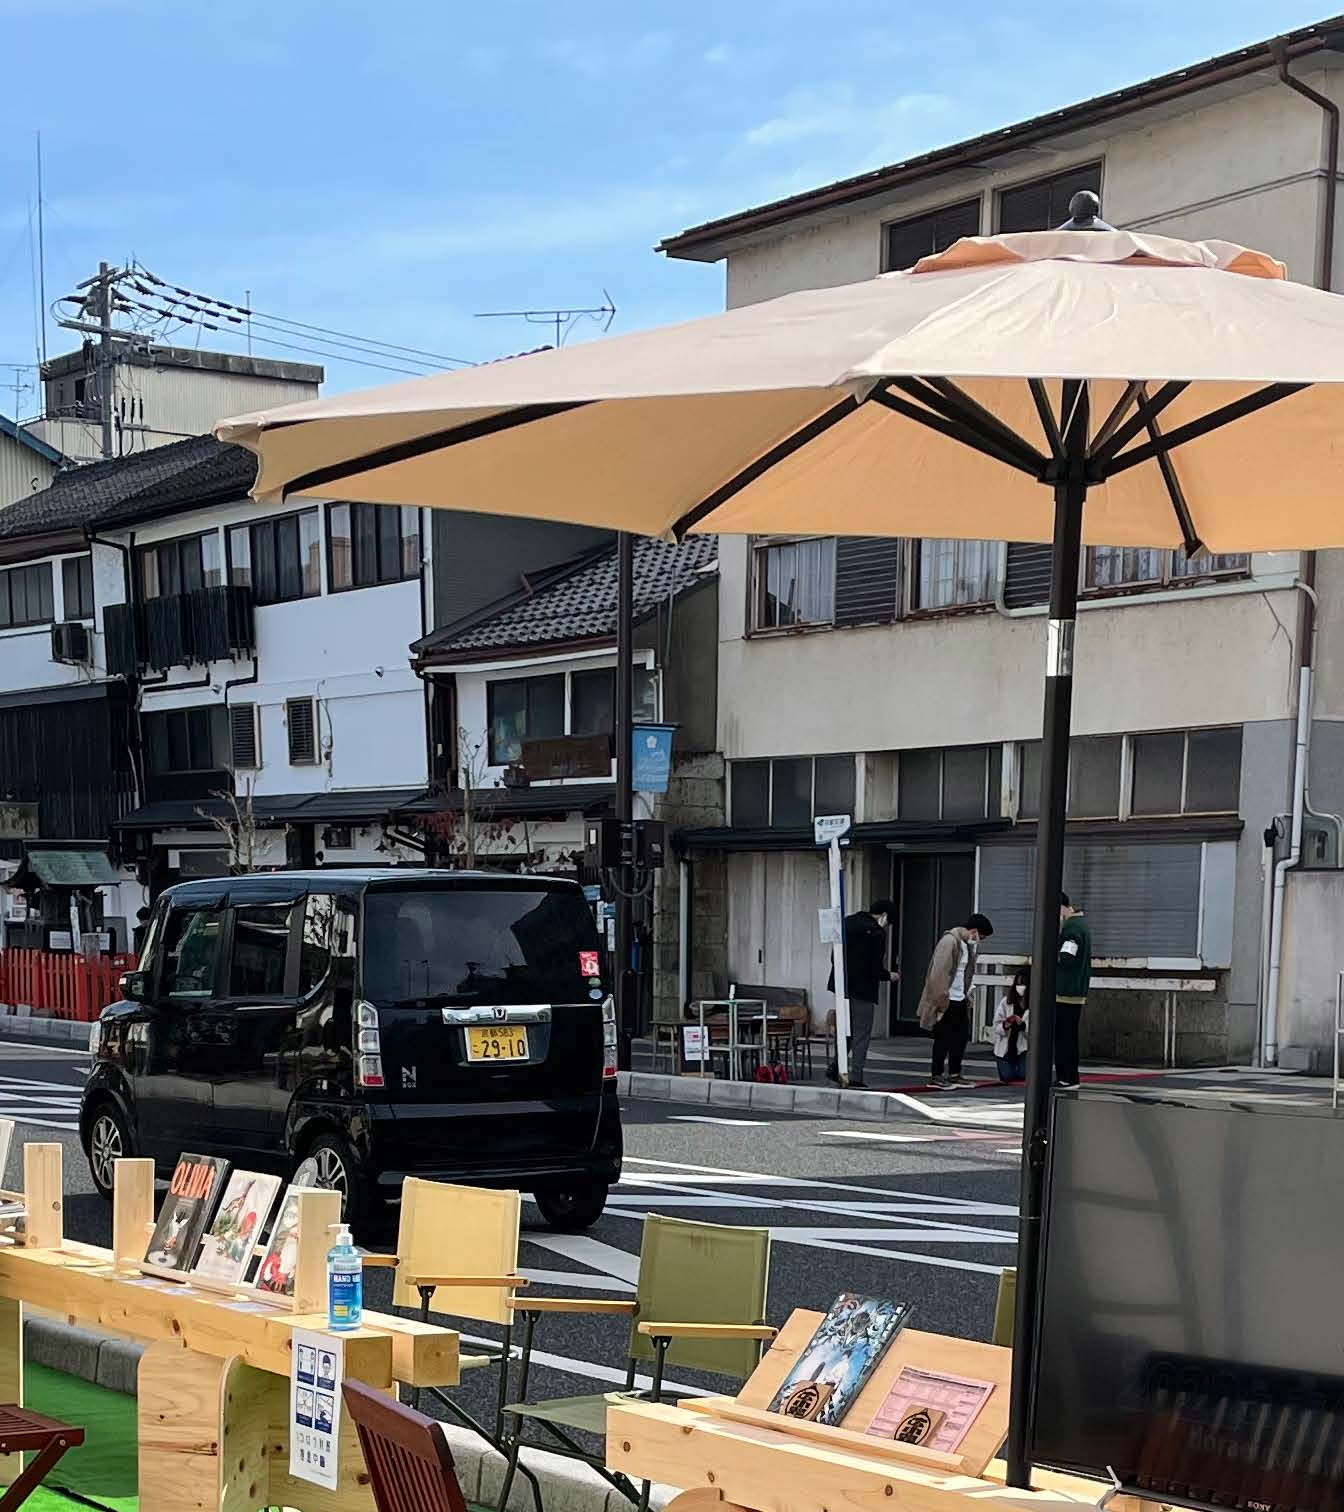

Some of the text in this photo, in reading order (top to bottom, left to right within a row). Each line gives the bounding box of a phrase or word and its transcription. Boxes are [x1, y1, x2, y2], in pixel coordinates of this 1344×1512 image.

[481, 1039, 526, 1058] 29-10
[170, 1161, 216, 1201] OLIVIA
[1247, 1500, 1271, 1512] SONY
